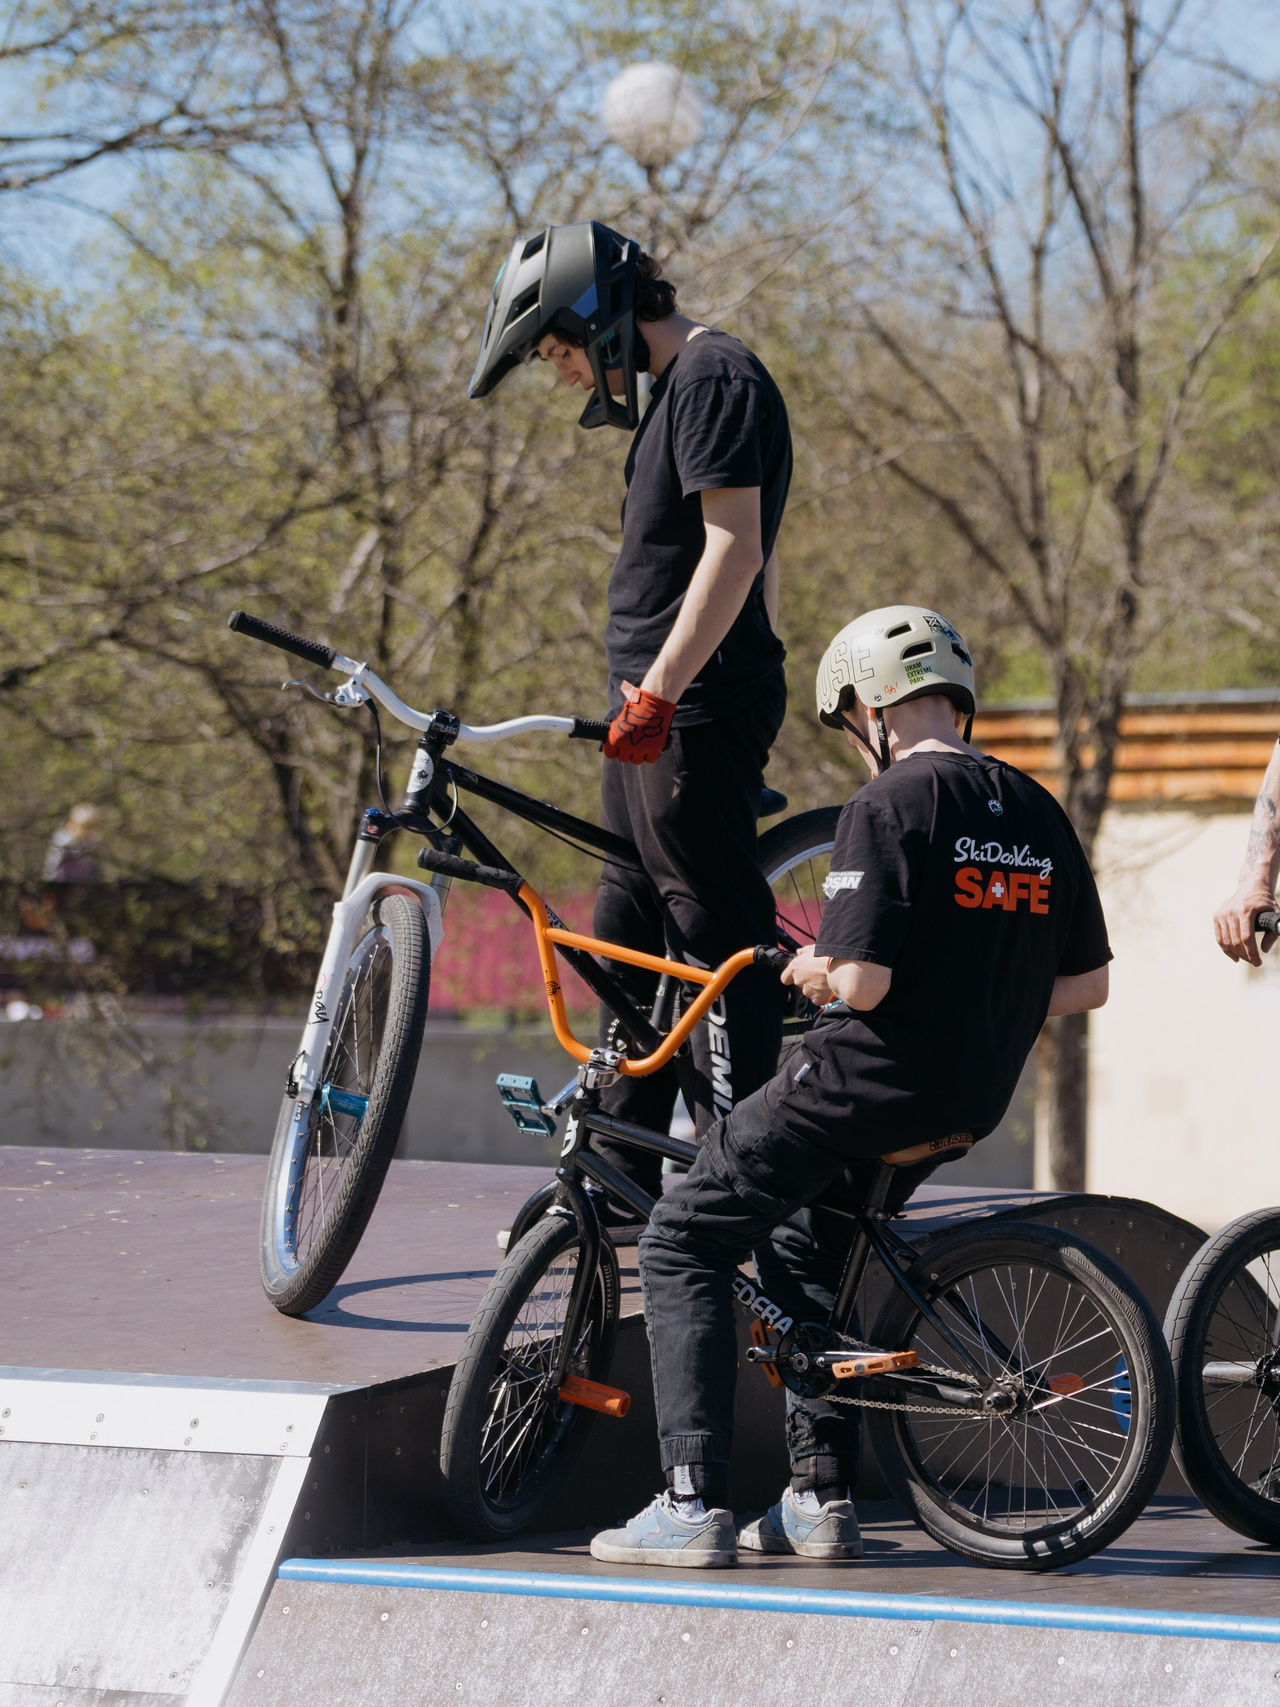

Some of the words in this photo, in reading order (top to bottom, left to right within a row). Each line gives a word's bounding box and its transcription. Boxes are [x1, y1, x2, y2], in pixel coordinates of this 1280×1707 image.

[817, 632, 875, 706] USE
[904, 661, 922, 672] URAM
[906, 666, 933, 679] EXTREME
[909, 676, 925, 685] PARK
[953, 866, 1052, 915] SAFE
[731, 1277, 794, 1336] EDERA
